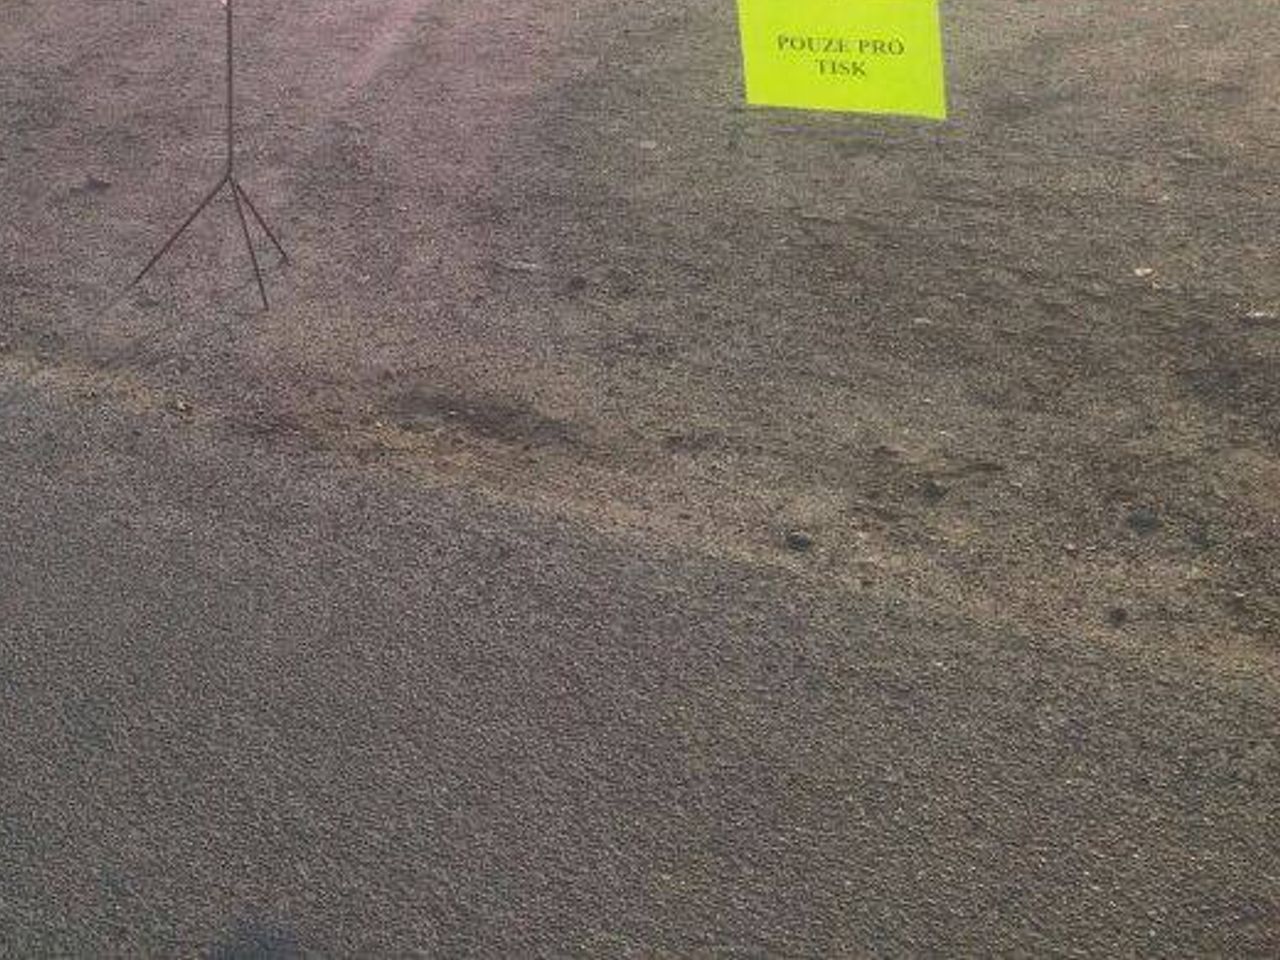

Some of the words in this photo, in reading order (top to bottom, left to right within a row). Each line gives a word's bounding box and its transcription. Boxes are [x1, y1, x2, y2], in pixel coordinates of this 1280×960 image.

[777, 34, 850, 53] POUZE
[858, 38, 905, 56] PRO
[816, 58, 867, 77] TISK
